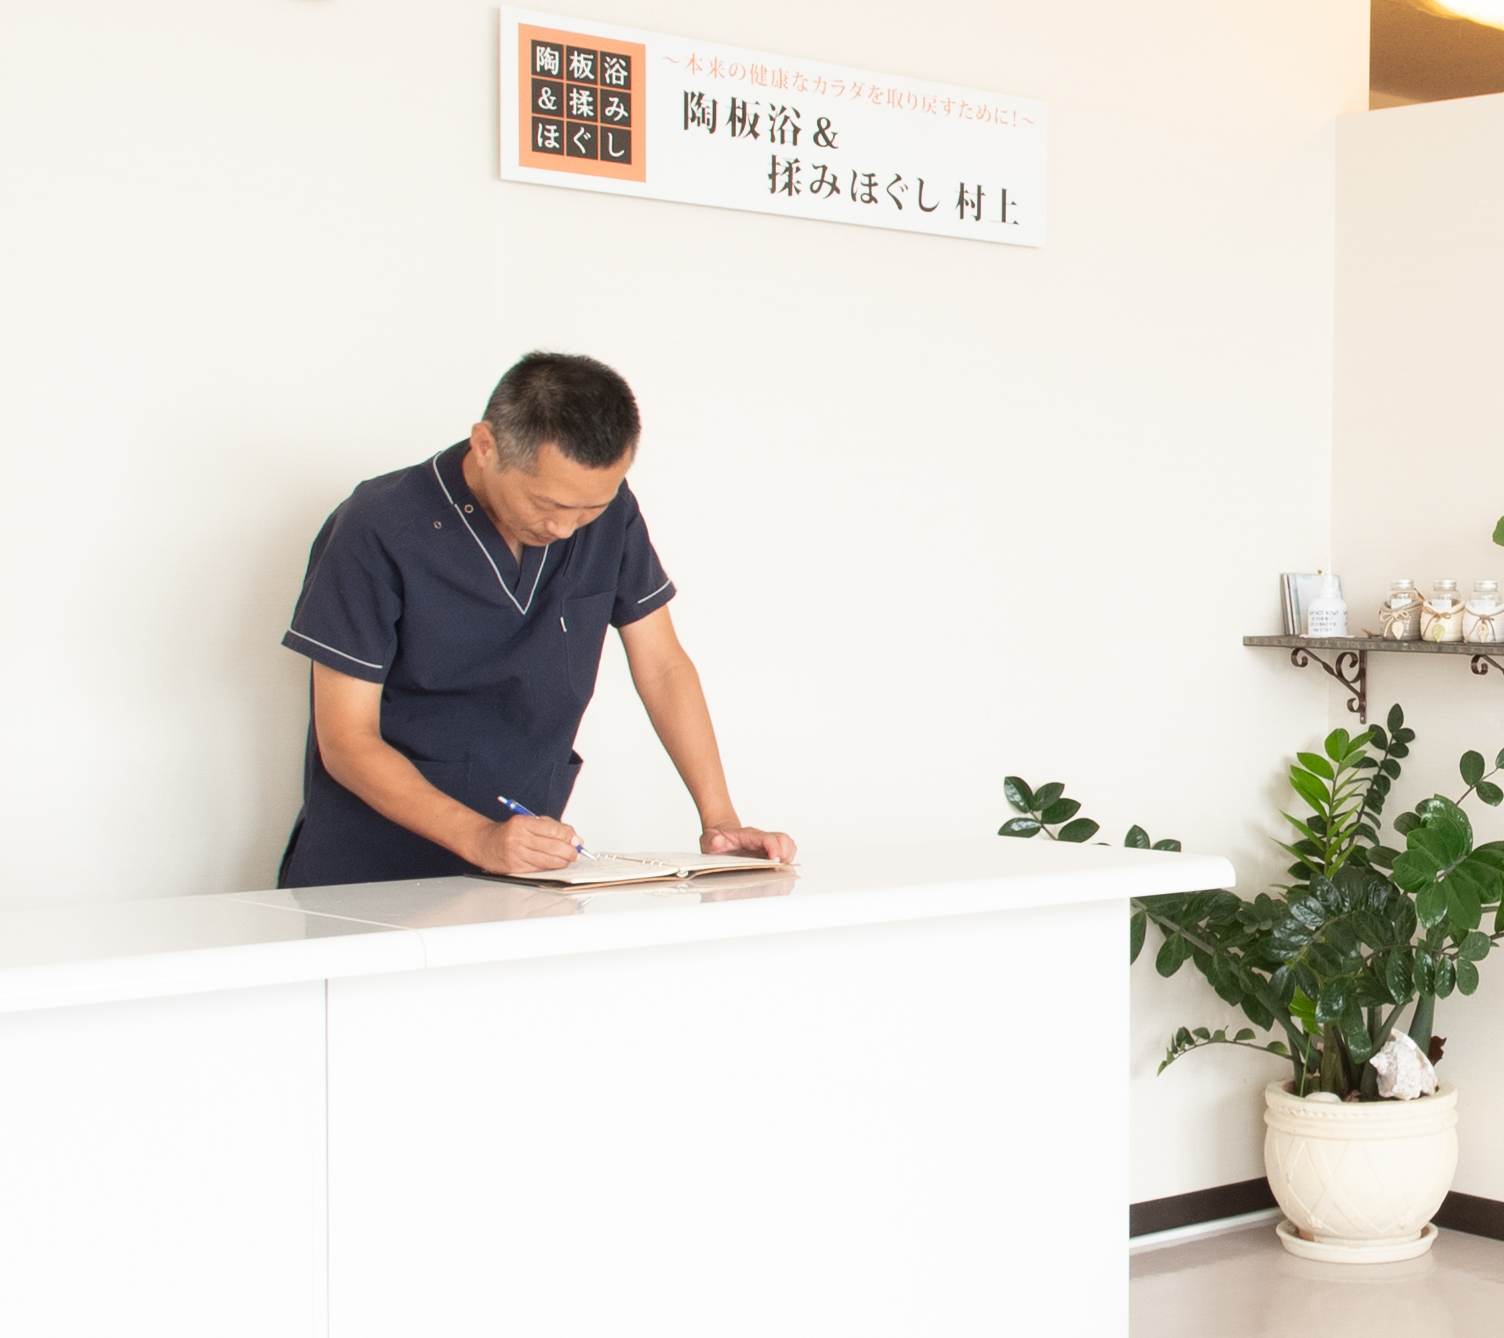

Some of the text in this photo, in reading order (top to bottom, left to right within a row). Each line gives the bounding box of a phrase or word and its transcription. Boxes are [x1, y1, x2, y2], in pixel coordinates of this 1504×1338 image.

[535, 45, 630, 86] 陶板浴
[536, 122, 627, 160] ほぐし
[767, 153, 1020, 226] 揉みほぐし 村上
